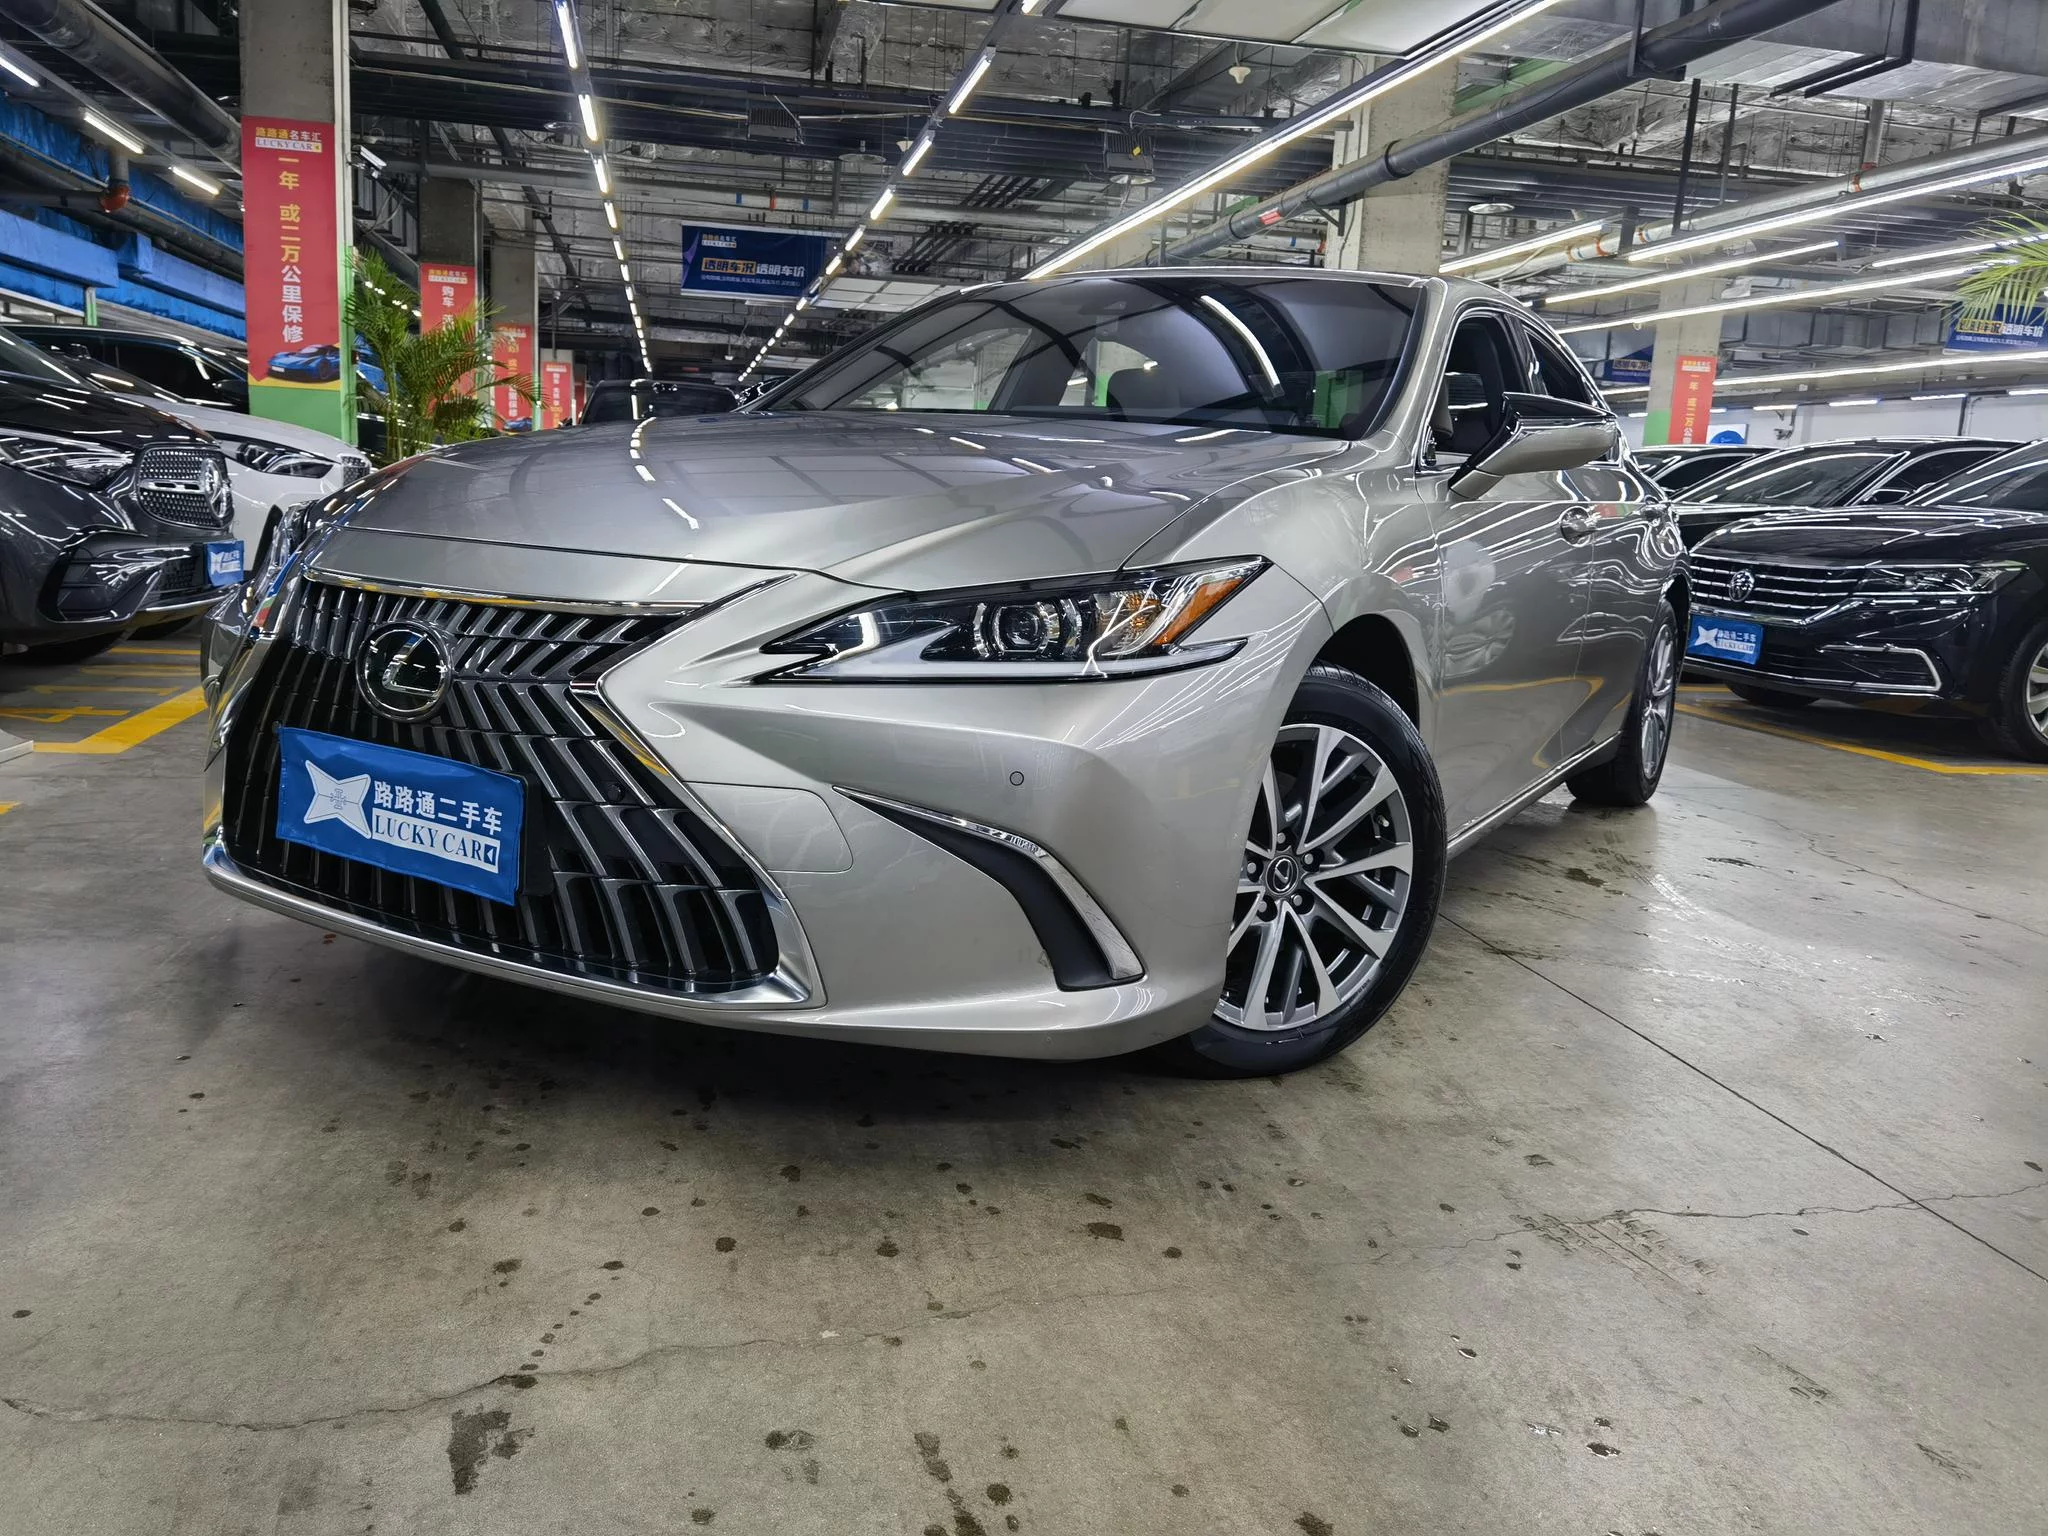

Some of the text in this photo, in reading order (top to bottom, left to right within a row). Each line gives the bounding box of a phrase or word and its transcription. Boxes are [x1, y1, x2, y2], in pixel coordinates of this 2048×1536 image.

[256, 127, 321, 141] 路路通名车汇
[257, 138, 313, 150] LUCKY CAR
[374, 780, 503, 836] 路路通二手车
[374, 814, 484, 864] LUCKY CAR
